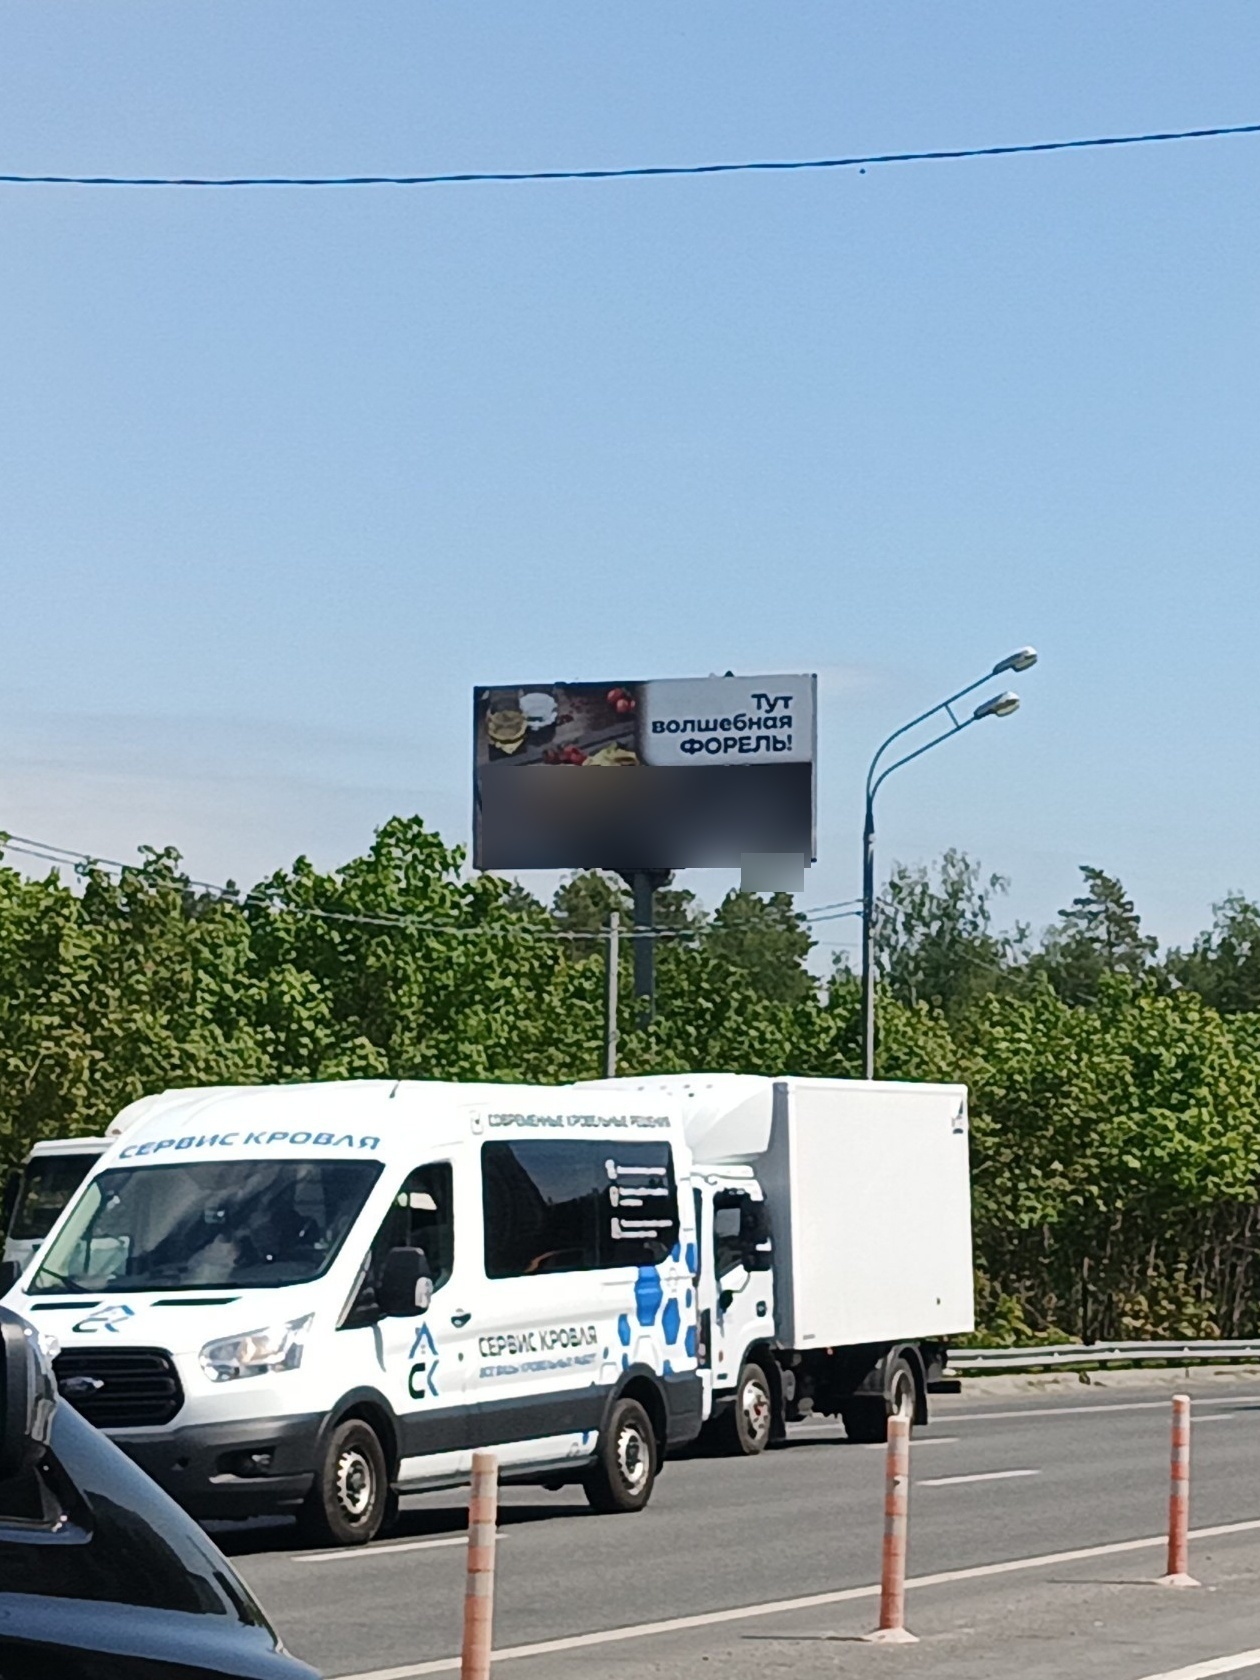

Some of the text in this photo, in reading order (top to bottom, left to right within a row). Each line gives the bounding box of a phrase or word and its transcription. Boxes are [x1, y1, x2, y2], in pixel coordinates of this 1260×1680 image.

[750, 693, 793, 711] Тут
[651, 713, 793, 734] волшебная
[679, 734, 793, 756] ФОРЕЛЬ!
[118, 1131, 381, 1159] СЕРВИС КРОВЛЯ
[478, 1325, 598, 1358] СЕРВИС КРОВЛЯ
